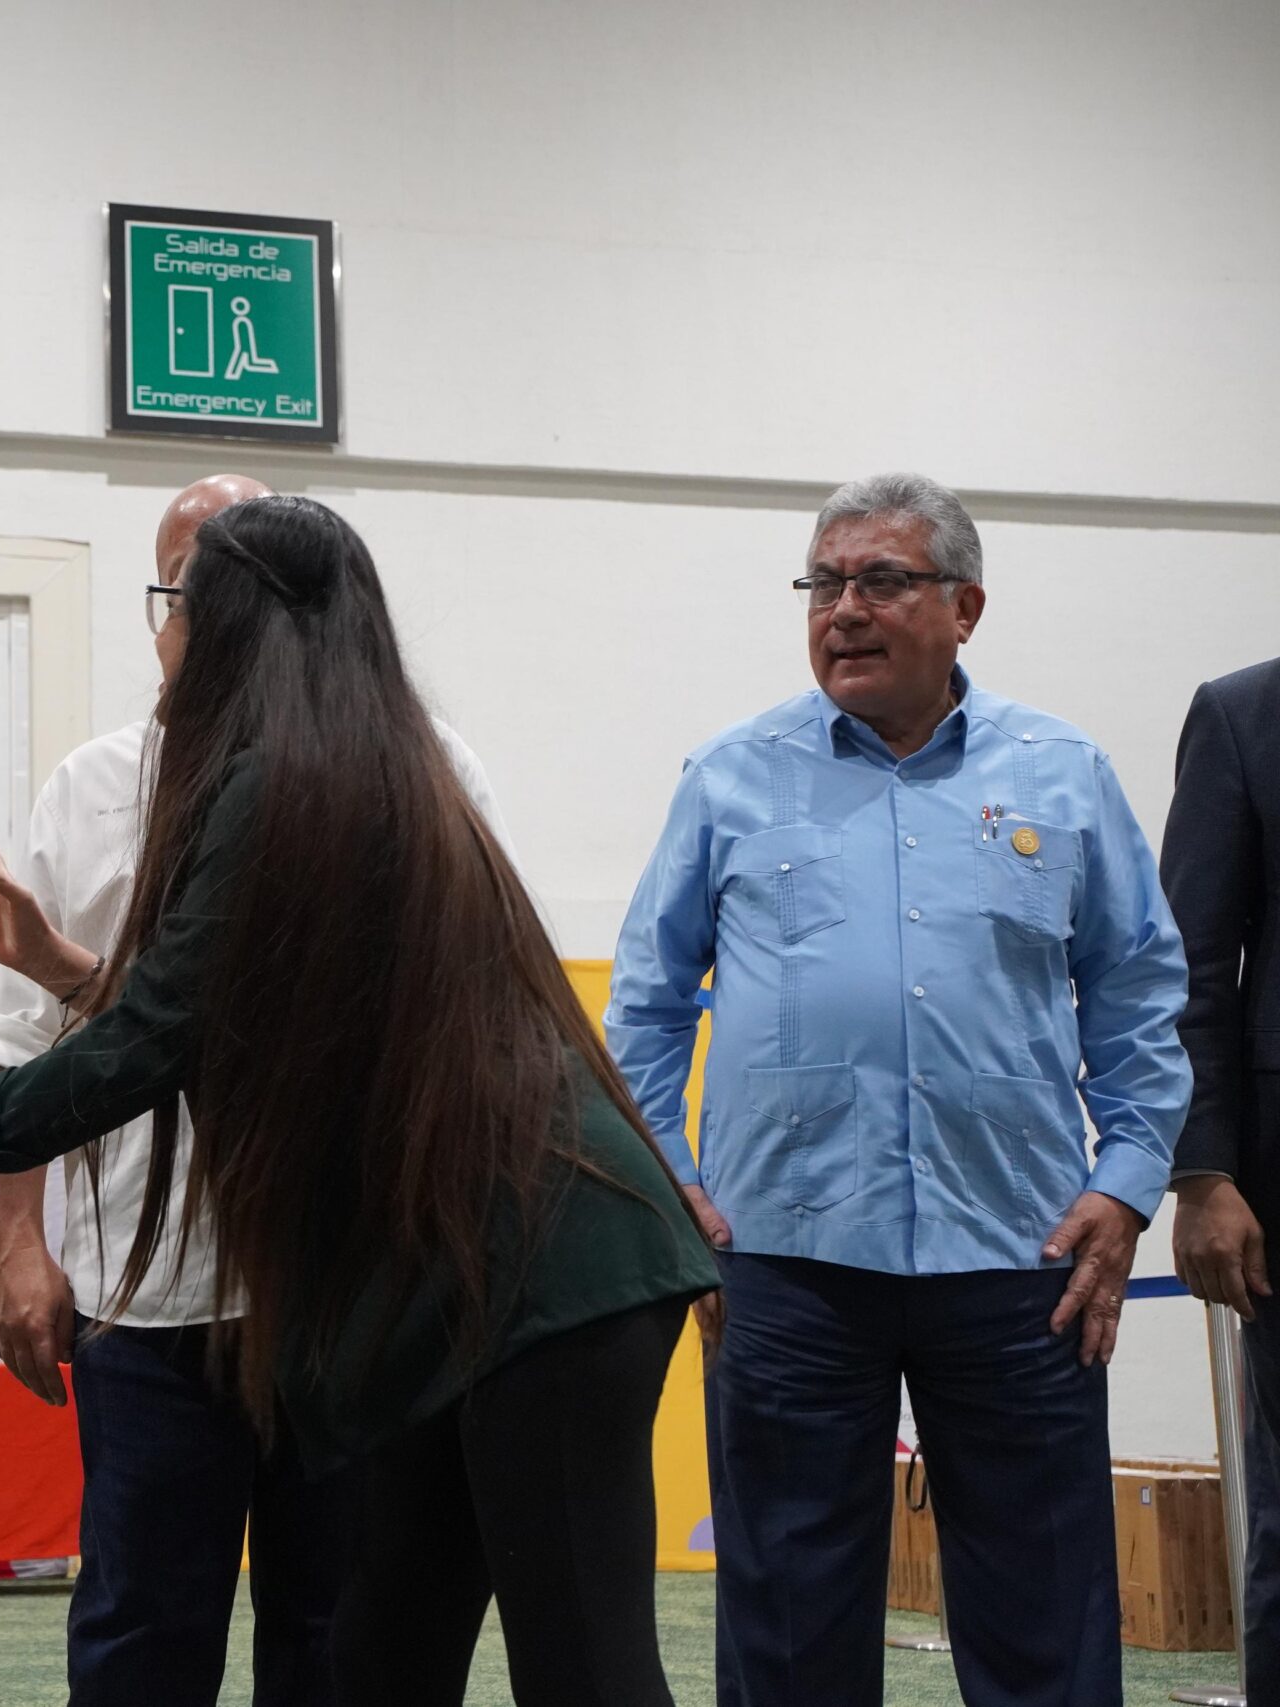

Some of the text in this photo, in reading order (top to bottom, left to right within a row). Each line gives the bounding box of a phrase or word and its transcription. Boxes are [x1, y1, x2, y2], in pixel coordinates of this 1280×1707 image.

[166, 234, 280, 261] Salida de
[153, 253, 292, 282] Emergencia
[136, 385, 313, 417] Emergency Exit
